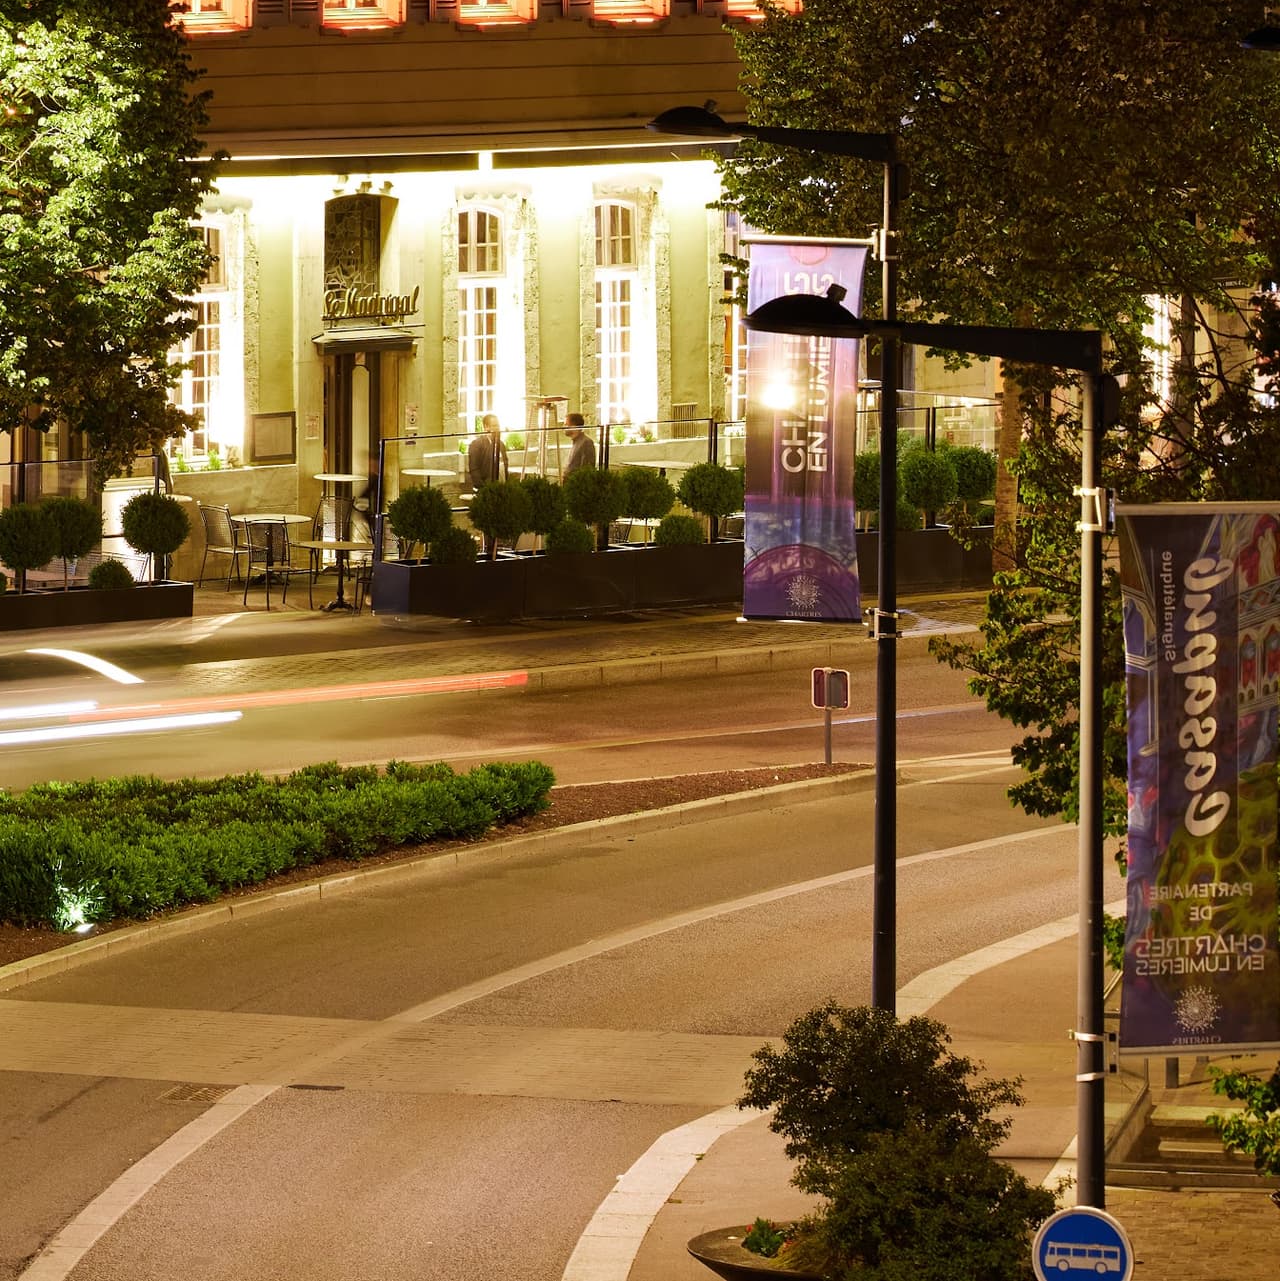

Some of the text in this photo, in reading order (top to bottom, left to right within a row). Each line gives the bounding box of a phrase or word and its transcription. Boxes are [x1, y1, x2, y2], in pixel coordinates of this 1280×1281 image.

[321, 285, 420, 322] Le Madrigal
[807, 431, 828, 472] EN
